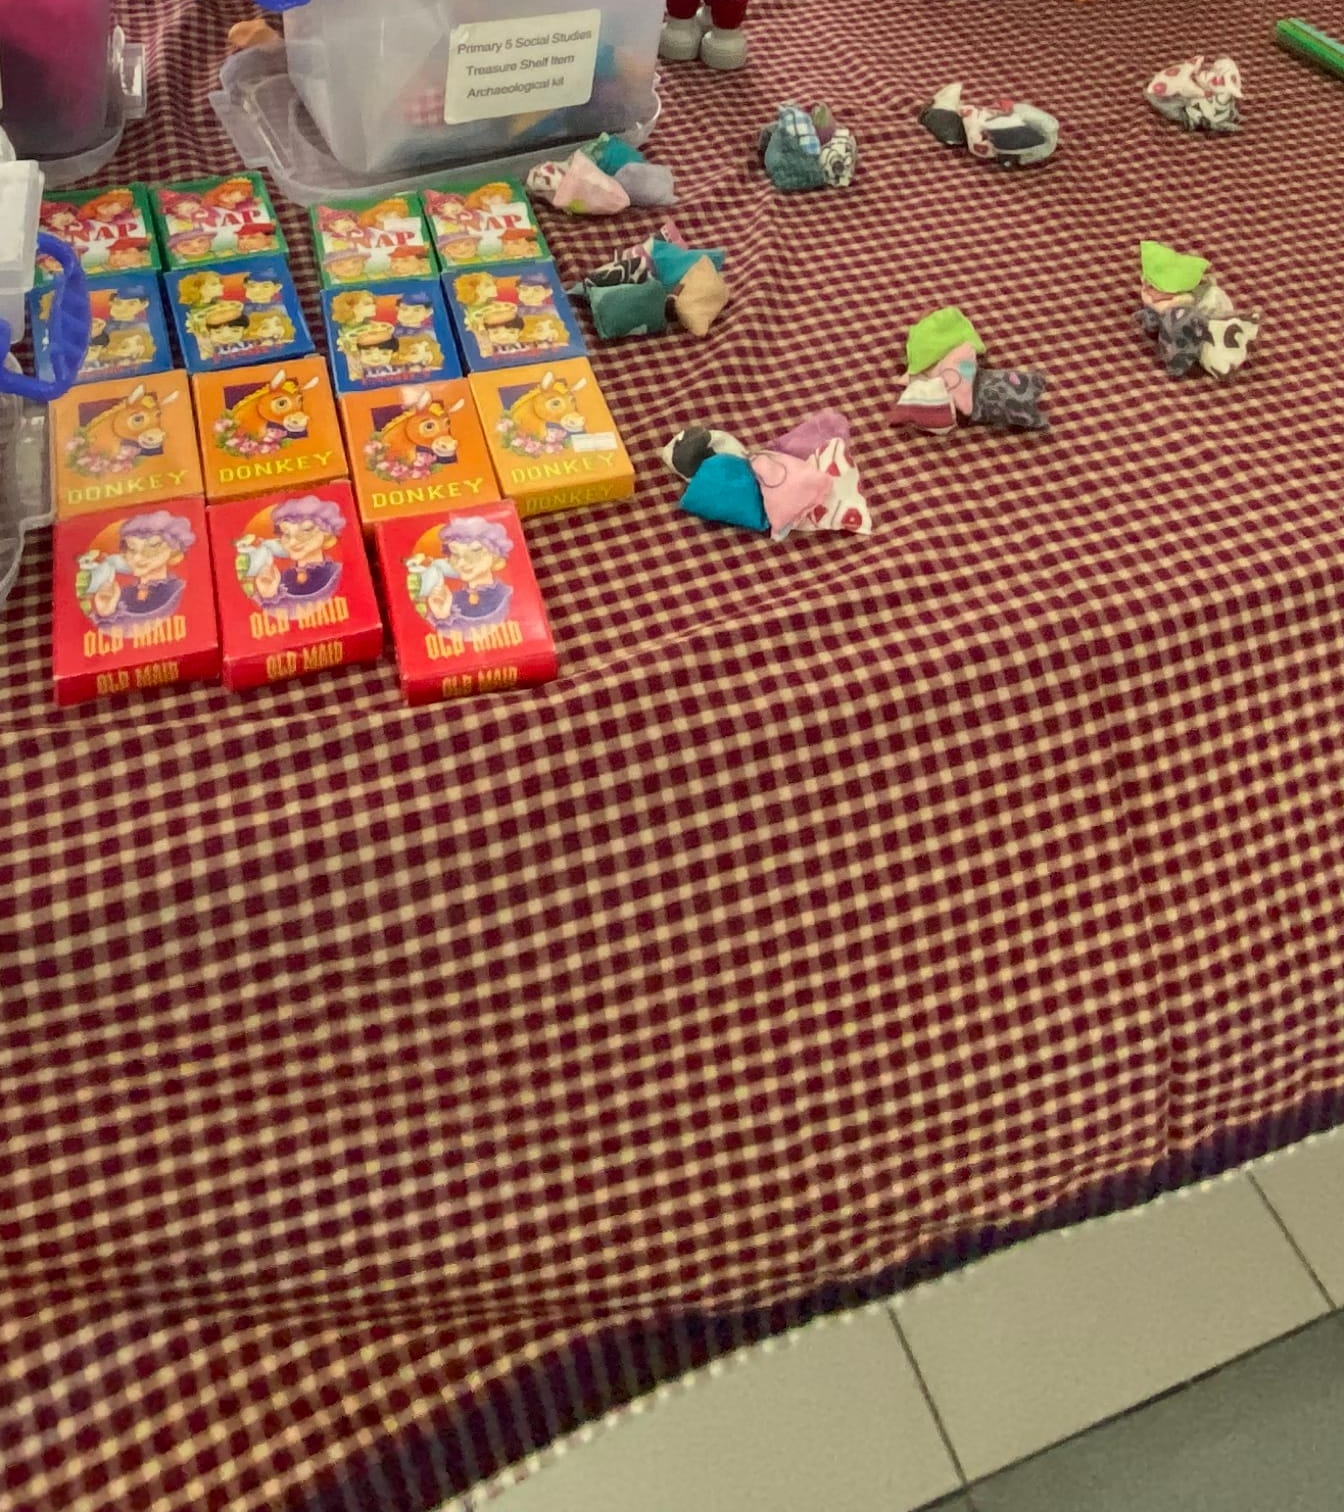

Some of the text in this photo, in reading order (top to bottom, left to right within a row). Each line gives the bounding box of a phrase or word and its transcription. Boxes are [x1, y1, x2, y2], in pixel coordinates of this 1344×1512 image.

[457, 30, 592, 55] Primary 5 Social Studies
[466, 54, 575, 76] Treasure Shelf Item
[467, 76, 564, 99] Archaeological kit
[218, 450, 334, 483] DONKEY
[511, 454, 617, 484] DONKEY
[67, 470, 188, 505] DONKEY
[371, 477, 484, 509] DONKEY
[526, 485, 614, 512] DONKEY
[249, 596, 350, 639] OLD MAID
[83, 615, 186, 658] OLD MAID
[425, 620, 523, 660] OLD MAID
[266, 641, 343, 679] OLD MAID
[96, 661, 179, 694] OLD MAID
